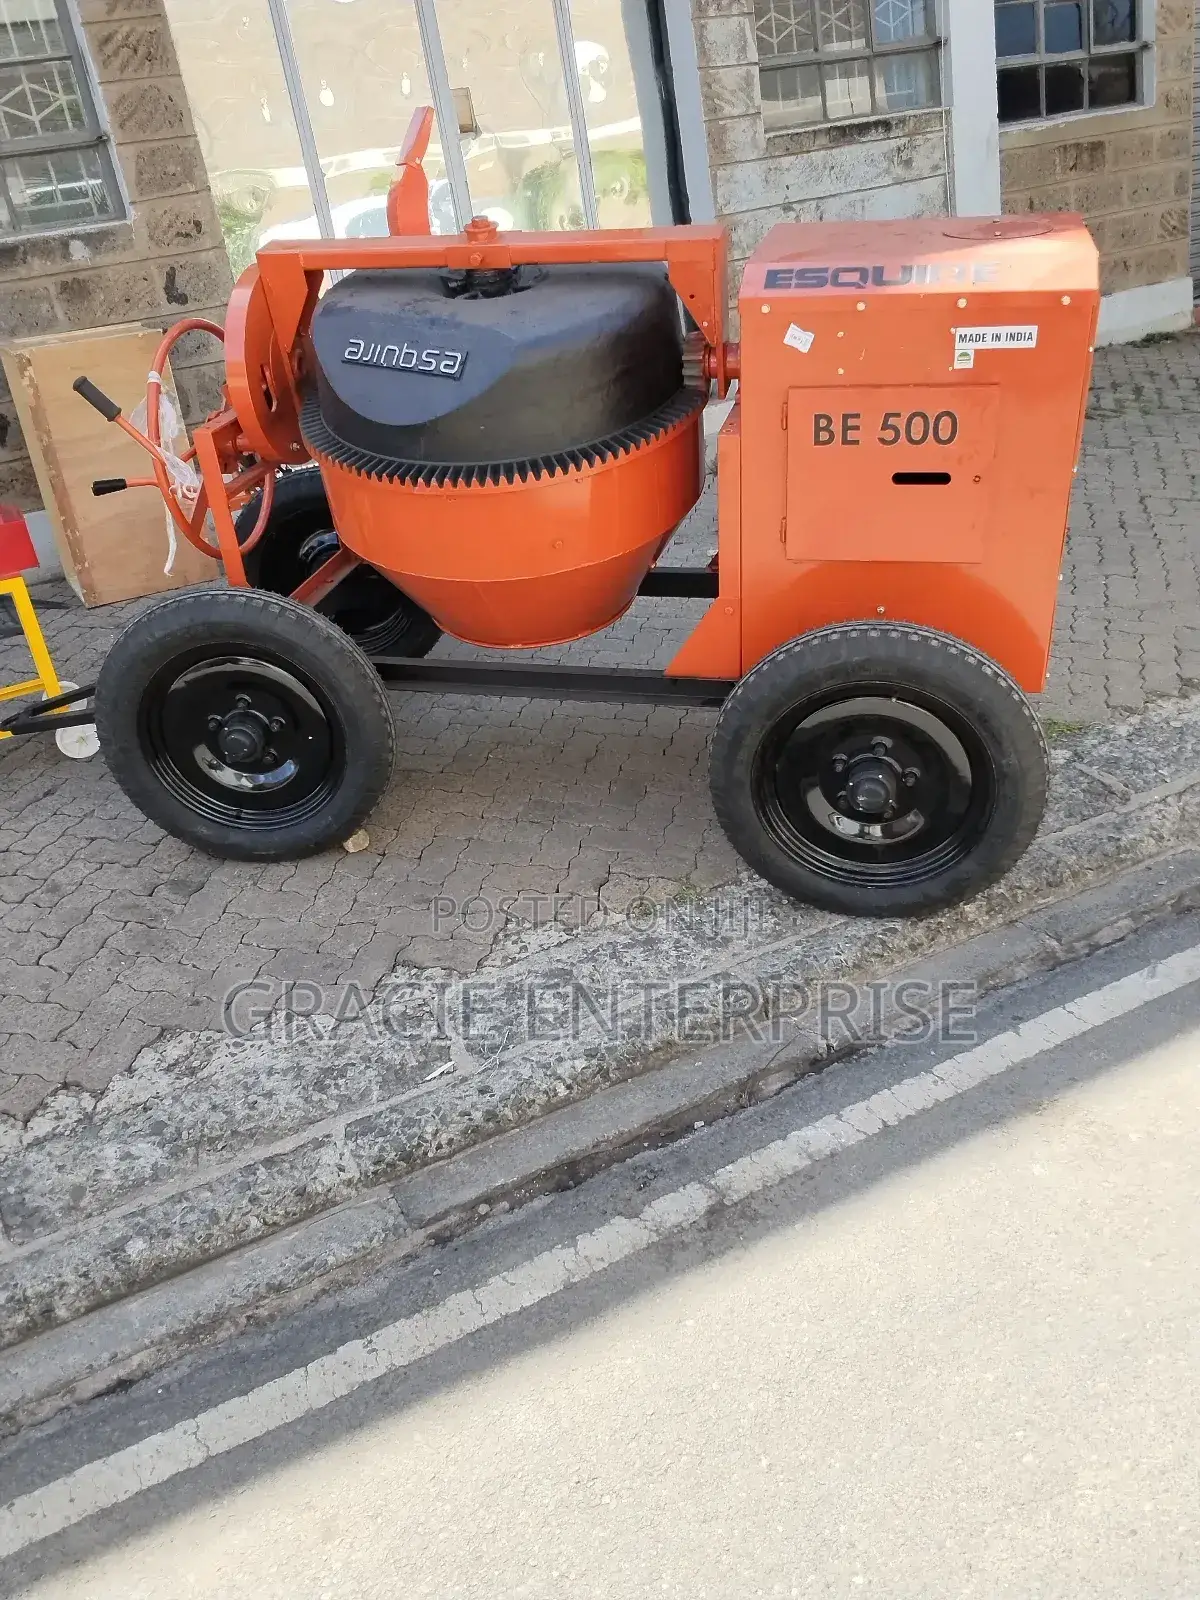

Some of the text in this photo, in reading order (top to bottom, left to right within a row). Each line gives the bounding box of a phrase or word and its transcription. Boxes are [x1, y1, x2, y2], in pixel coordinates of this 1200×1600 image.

[764, 263, 1000, 290] ESQUIRE
[958, 331, 1033, 344] MADE IN INDIA
[813, 410, 958, 446] BE 500
